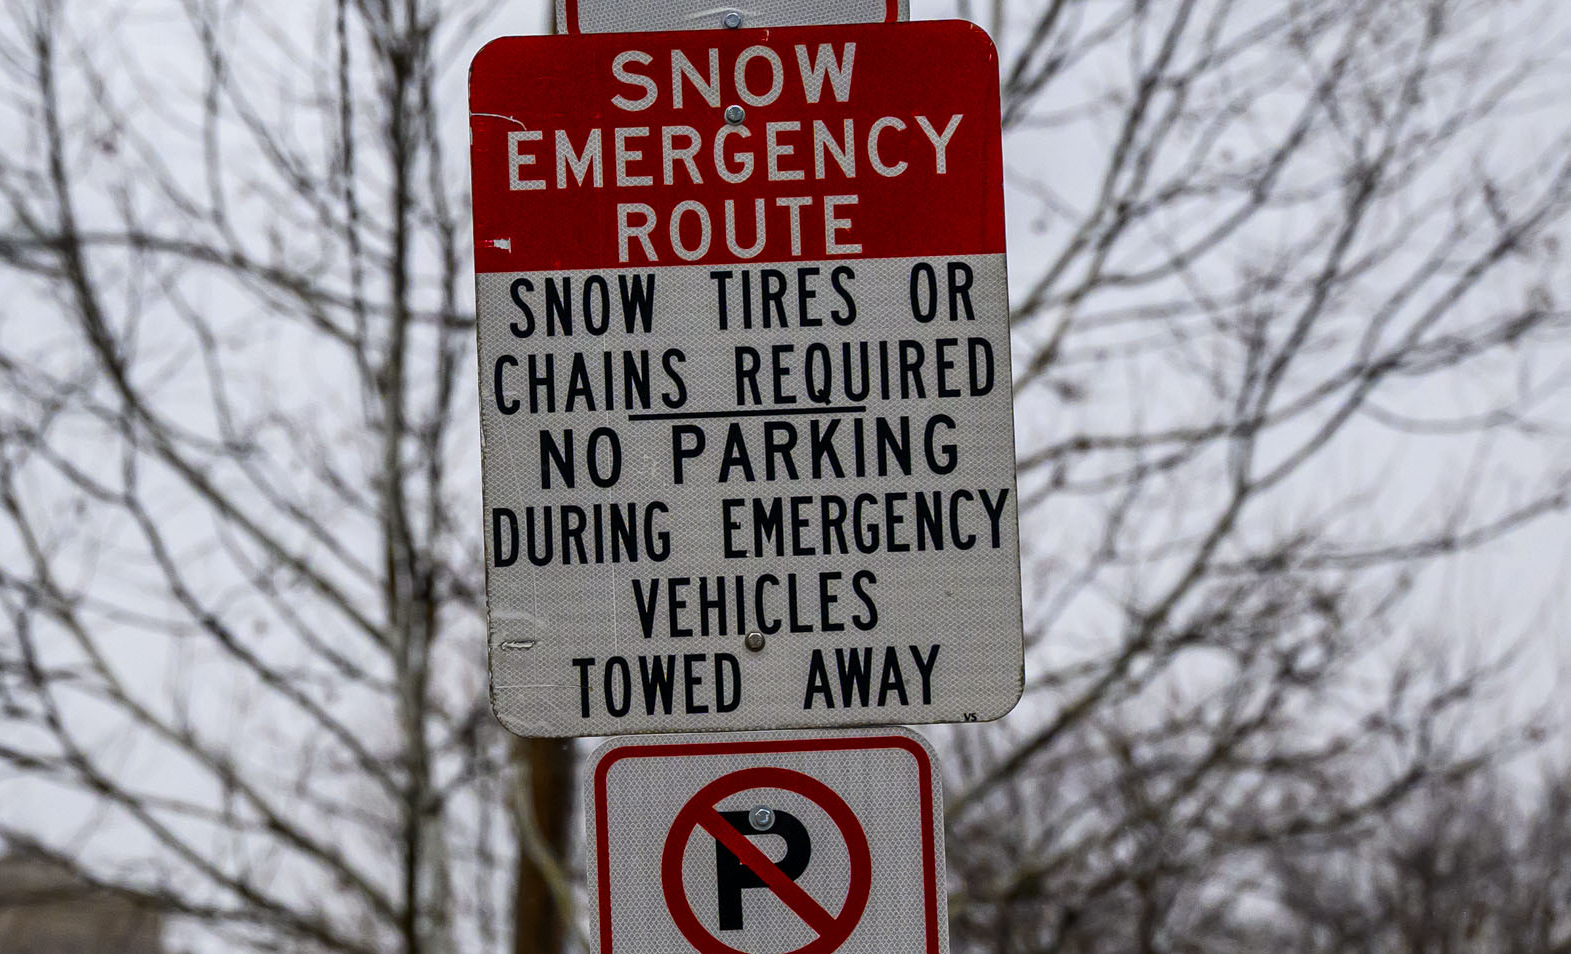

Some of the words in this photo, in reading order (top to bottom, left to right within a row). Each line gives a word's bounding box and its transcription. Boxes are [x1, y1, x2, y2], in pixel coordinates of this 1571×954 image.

[611, 42, 856, 111] SNOW
[507, 114, 964, 191] EMERGENCY
[617, 195, 863, 263] ROUTE
[510, 273, 656, 338] SNOW
[710, 265, 857, 330] TIRES
[909, 262, 975, 323] OR
[494, 348, 688, 415] CHAINS
[734, 337, 995, 405] REQUIRED
[539, 427, 623, 490] NO
[671, 414, 959, 485] PARKING
[492, 501, 671, 567] DURING
[722, 488, 1009, 559] EMERGENCY
[631, 570, 878, 639] VEHICLES
[572, 653, 741, 718] TOWED
[804, 644, 940, 710] AWAY
[713, 809, 812, 931] P
